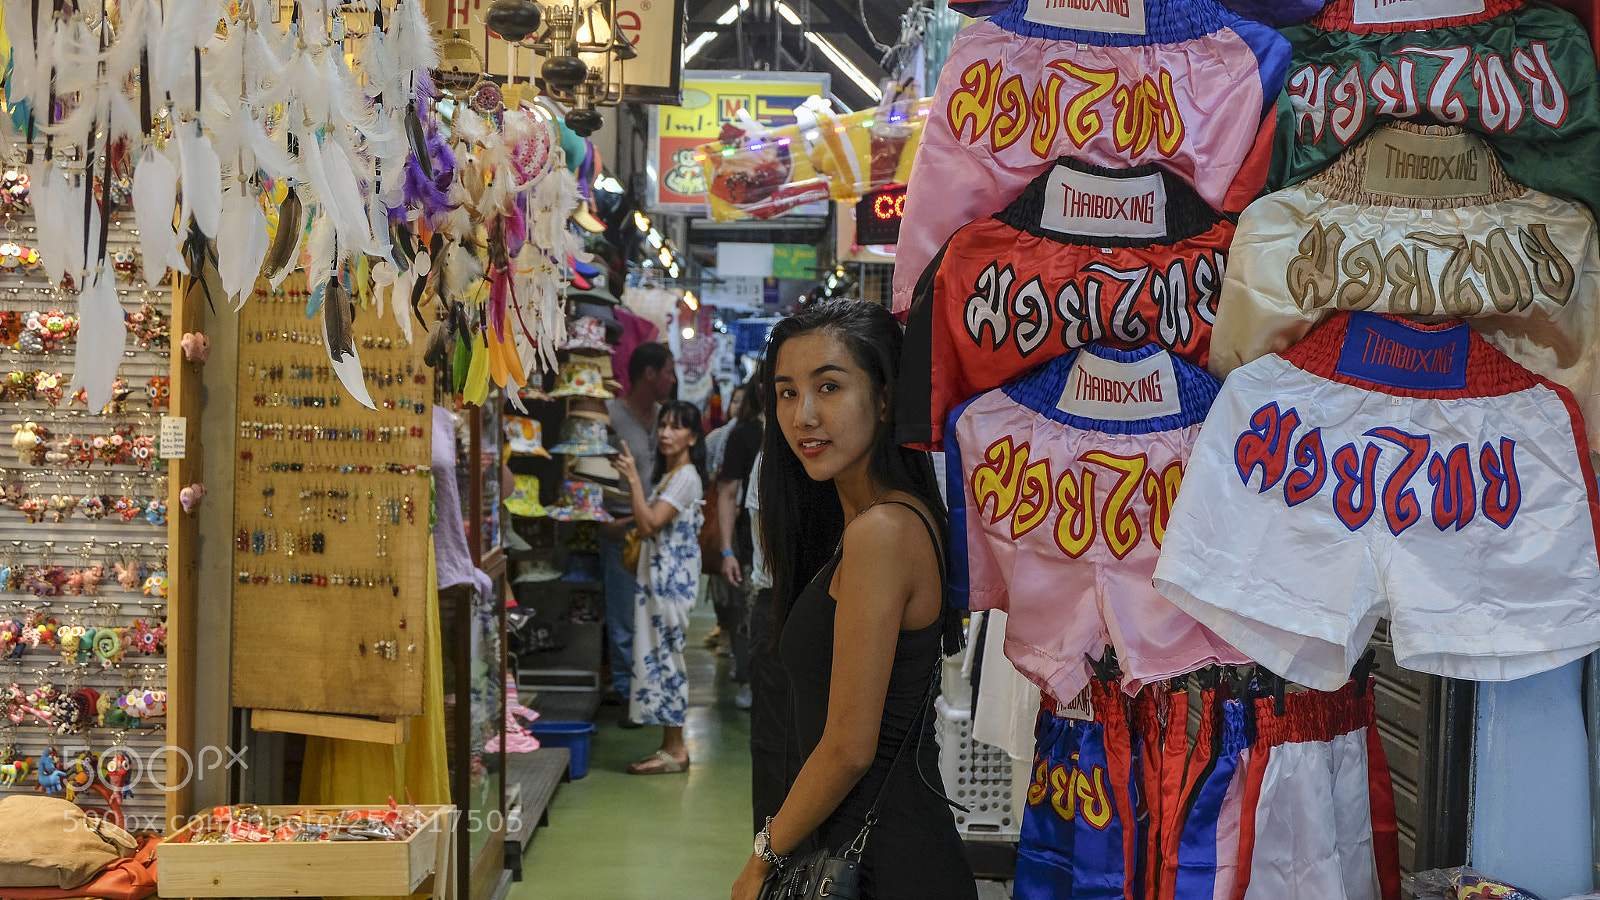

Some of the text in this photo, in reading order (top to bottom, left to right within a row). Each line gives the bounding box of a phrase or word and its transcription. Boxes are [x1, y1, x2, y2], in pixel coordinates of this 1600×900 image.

[947, 58, 1186, 159] มวยไทย
[1288, 42, 1568, 146] มวยไทย
[1061, 182, 1154, 224] THAIBOXING
[1384, 143, 1478, 182] THAIBOXING
[1286, 220, 1575, 316] มวยไทย
[1075, 364, 1163, 404] THAIBOXING
[1361, 327, 1457, 374] THAIBOXING
[971, 434, 1192, 560] มวยไท
[1234, 401, 1522, 537] มวยไทย
